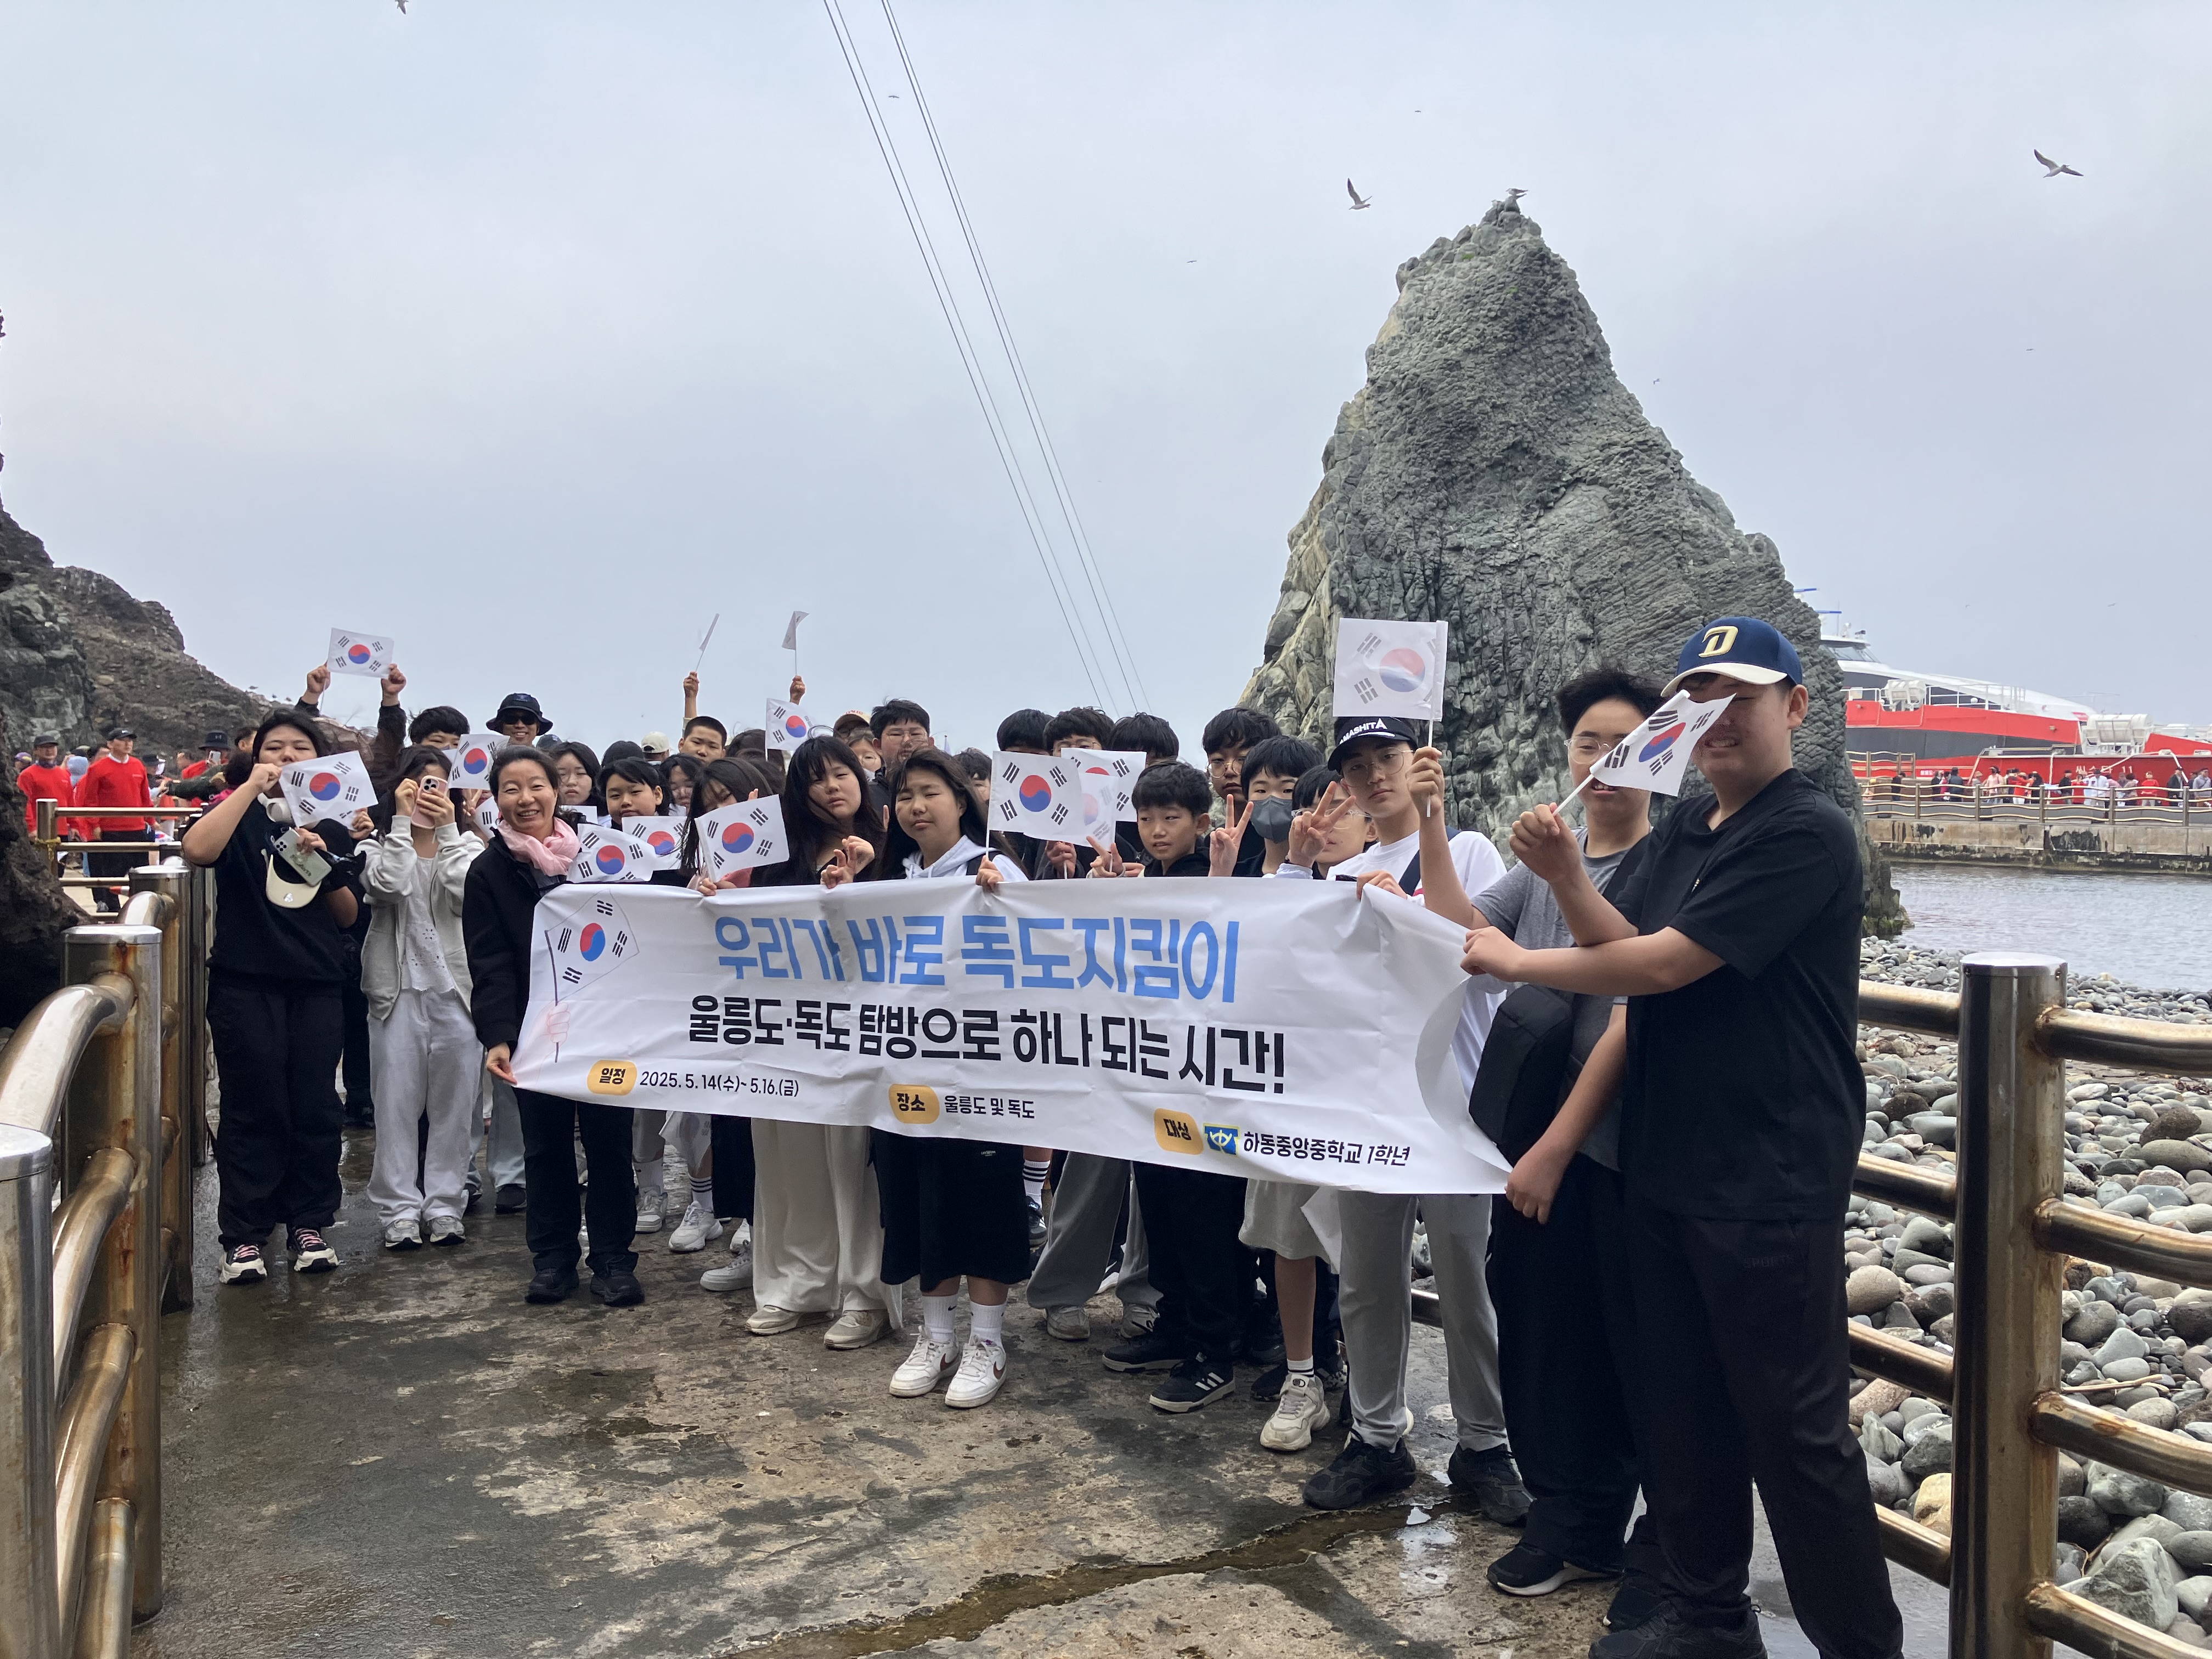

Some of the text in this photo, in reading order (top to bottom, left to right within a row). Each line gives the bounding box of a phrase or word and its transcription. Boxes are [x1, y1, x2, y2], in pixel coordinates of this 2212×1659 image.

[1698, 625, 1739, 657] D
[1339, 718, 1387, 744] AMASHITA
[715, 915, 1239, 1003] 우리가 바로 독도지킴이
[689, 995, 1284, 1094] 울릉도·독도 탐방으로 하나 되는 시간!
[599, 1068, 627, 1085] 일정
[640, 1071, 681, 1088] 2025.
[896, 1092, 926, 1111] 장소
[944, 1095, 1035, 1119] 울릉도 및 독도
[1243, 1131, 1411, 1166] 하동중앙중학교 1학년
